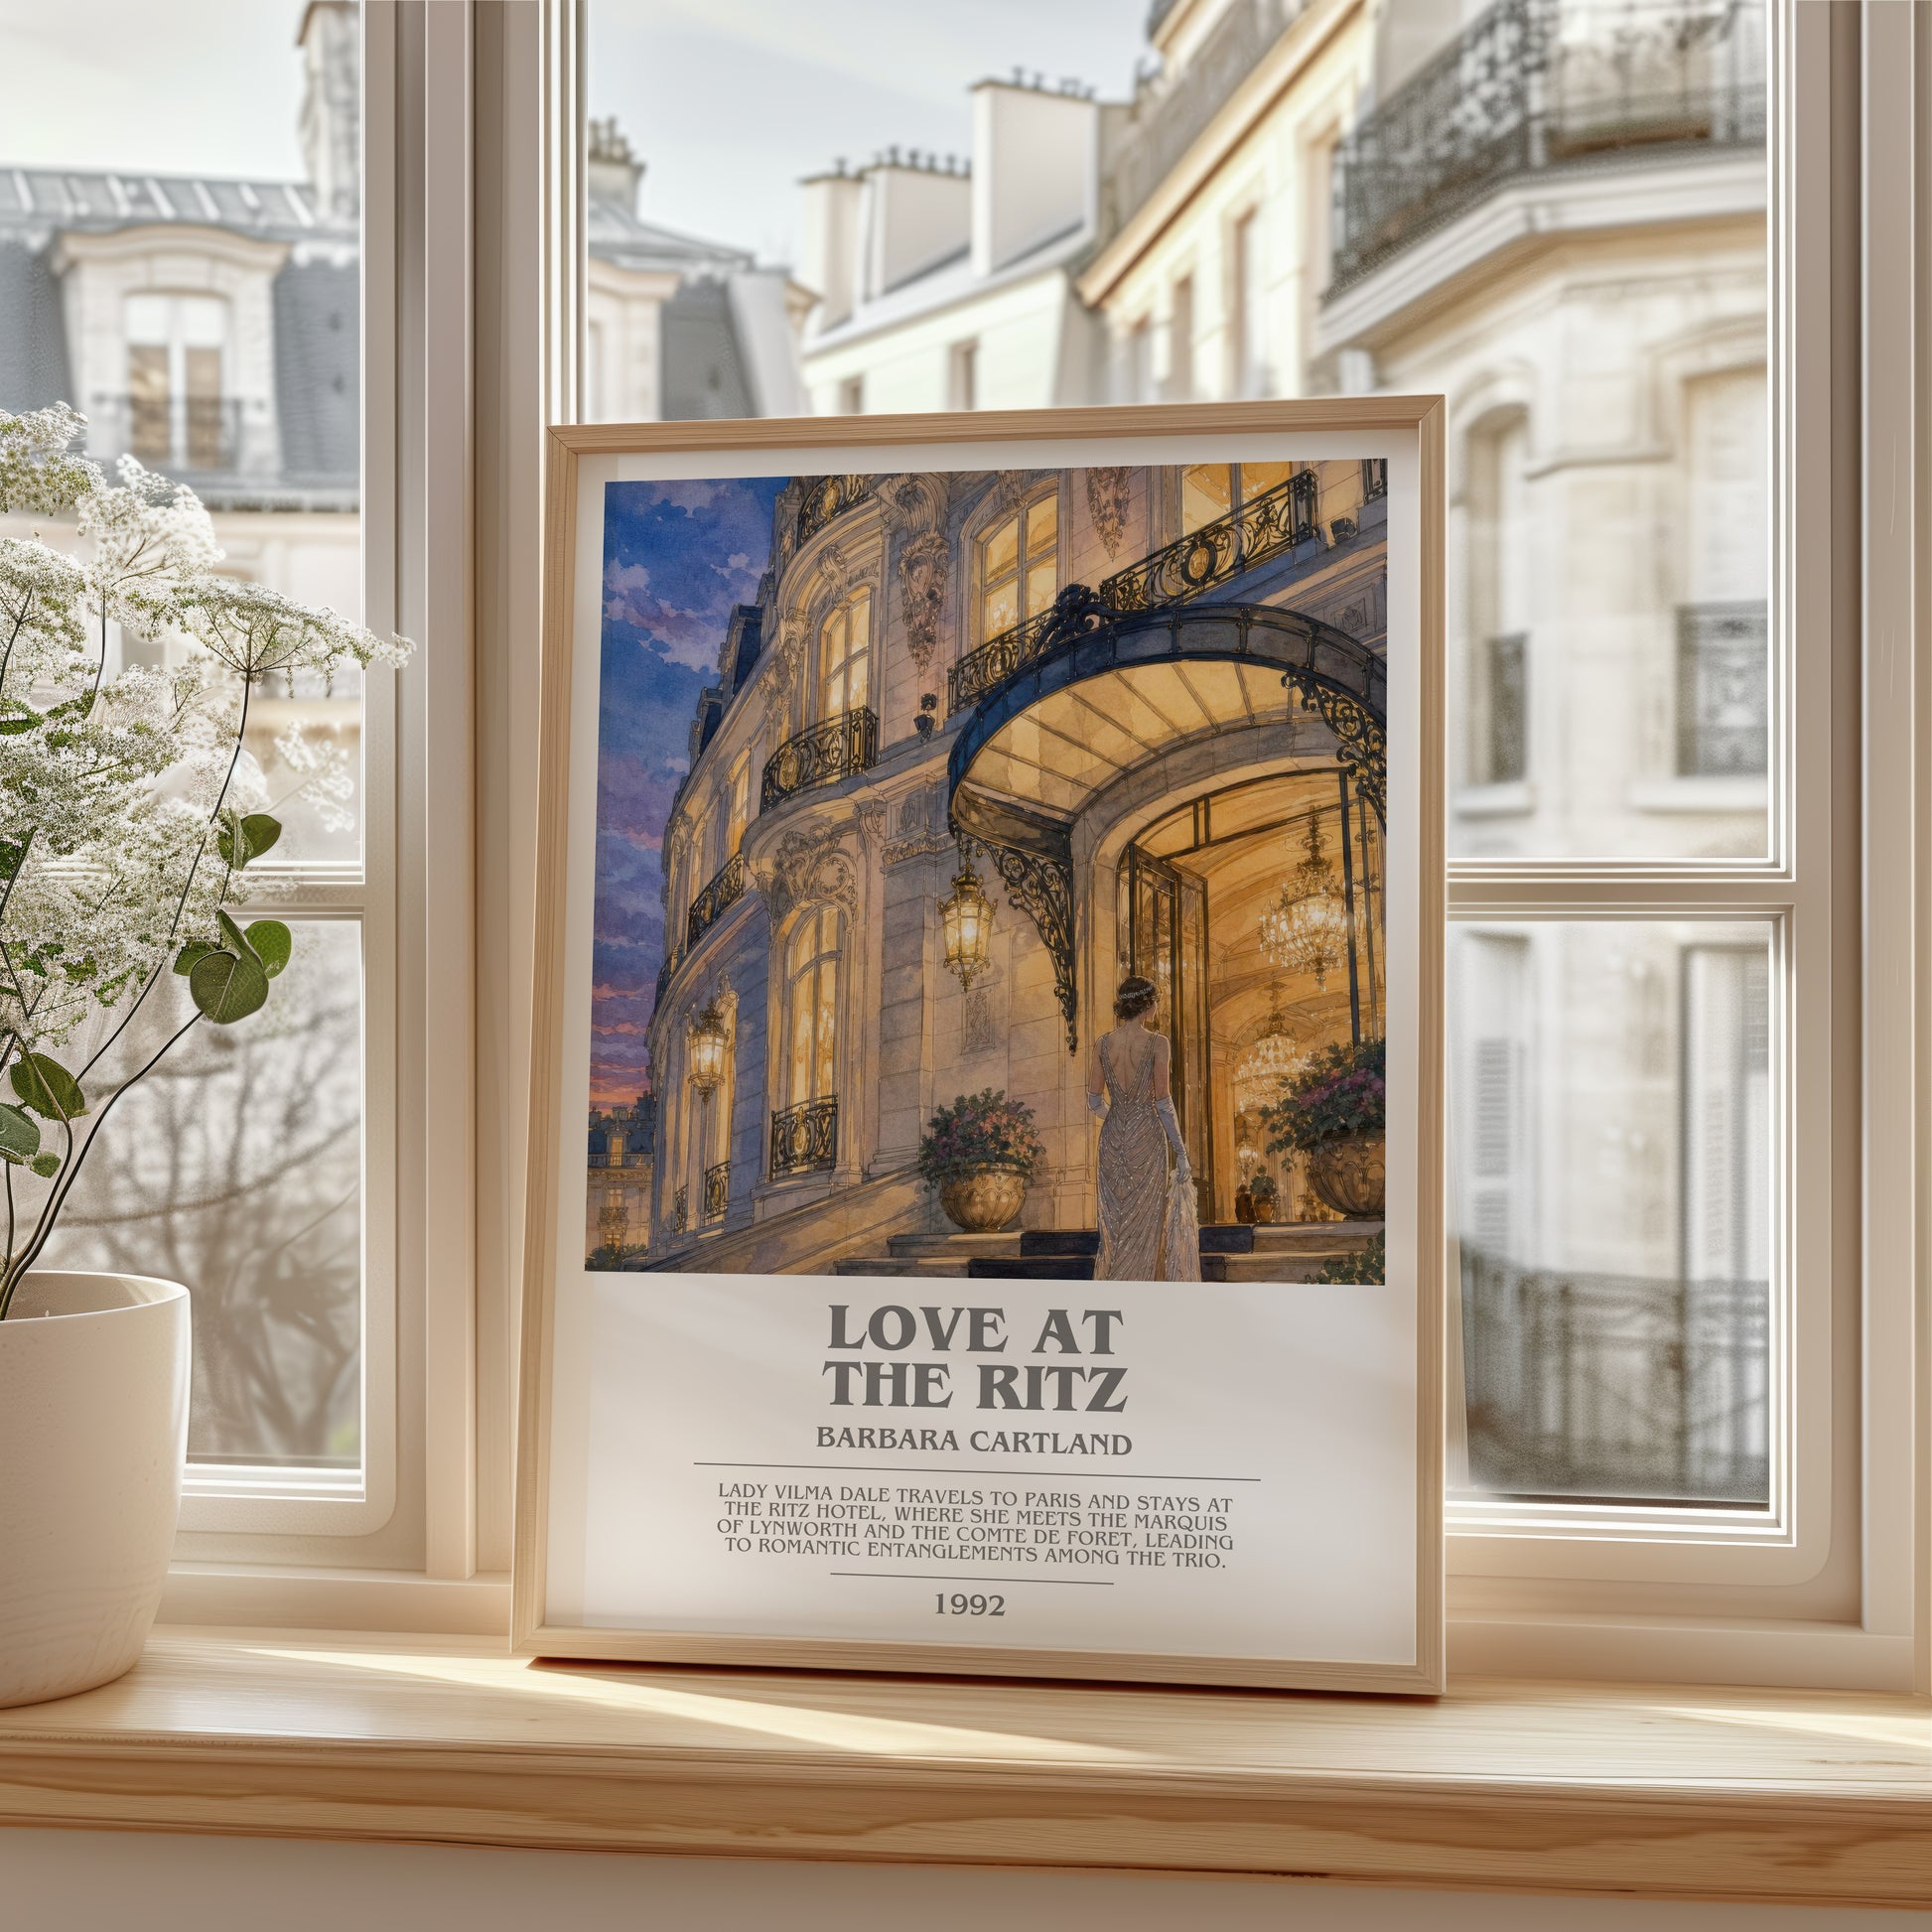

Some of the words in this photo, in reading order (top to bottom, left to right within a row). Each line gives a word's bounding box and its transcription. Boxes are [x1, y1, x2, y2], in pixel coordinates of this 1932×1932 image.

[827, 1304, 1009, 1353] LOVE
[1031, 1309, 1124, 1355] AT
[821, 1359, 953, 1409] THE
[975, 1363, 1128, 1413] RITZ
[815, 1426, 960, 1450] BARBARA
[969, 1430, 1132, 1455] CARTLAND
[718, 1482, 768, 1498] LADY
[773, 1484, 833, 1500] VILMA
[839, 1485, 891, 1502] DALE
[896, 1487, 983, 1505] TRAVELS
[989, 1490, 1018, 1506] TO
[1024, 1491, 1081, 1508] PARIS
[1087, 1493, 1130, 1509] AND
[1136, 1494, 1200, 1512] STAYS
[1206, 1497, 1233, 1513] AT
[723, 1500, 762, 1517] THE
[767, 1501, 810, 1518] RITZ
[816, 1503, 886, 1522] HOTEL,
[894, 1505, 964, 1523] WHERE
[969, 1507, 1010, 1524] SHE
[1016, 1509, 1081, 1526] MEETS
[1086, 1511, 1128, 1528] THE
[1133, 1513, 1227, 1532] MARQUIS
[716, 1518, 744, 1534] OF
[749, 1519, 857, 1537] LYNWORTH
[863, 1523, 904, 1539] AND
[910, 1524, 951, 1541] THE
[955, 1526, 1027, 1543] COMTE
[1033, 1528, 1060, 1544] DE
[1066, 1530, 1137, 1549] FORET,
[1145, 1532, 1233, 1550] LEADING
[723, 1536, 752, 1552] TO
[758, 1537, 861, 1556] ROMANTIC
[867, 1541, 1037, 1562] ENTANGLEMENTS
[1043, 1547, 1119, 1565] AMONG
[1125, 1550, 1167, 1567] THE
[1171, 1552, 1225, 1569] TRIO.
[934, 1592, 1006, 1616] 1992
